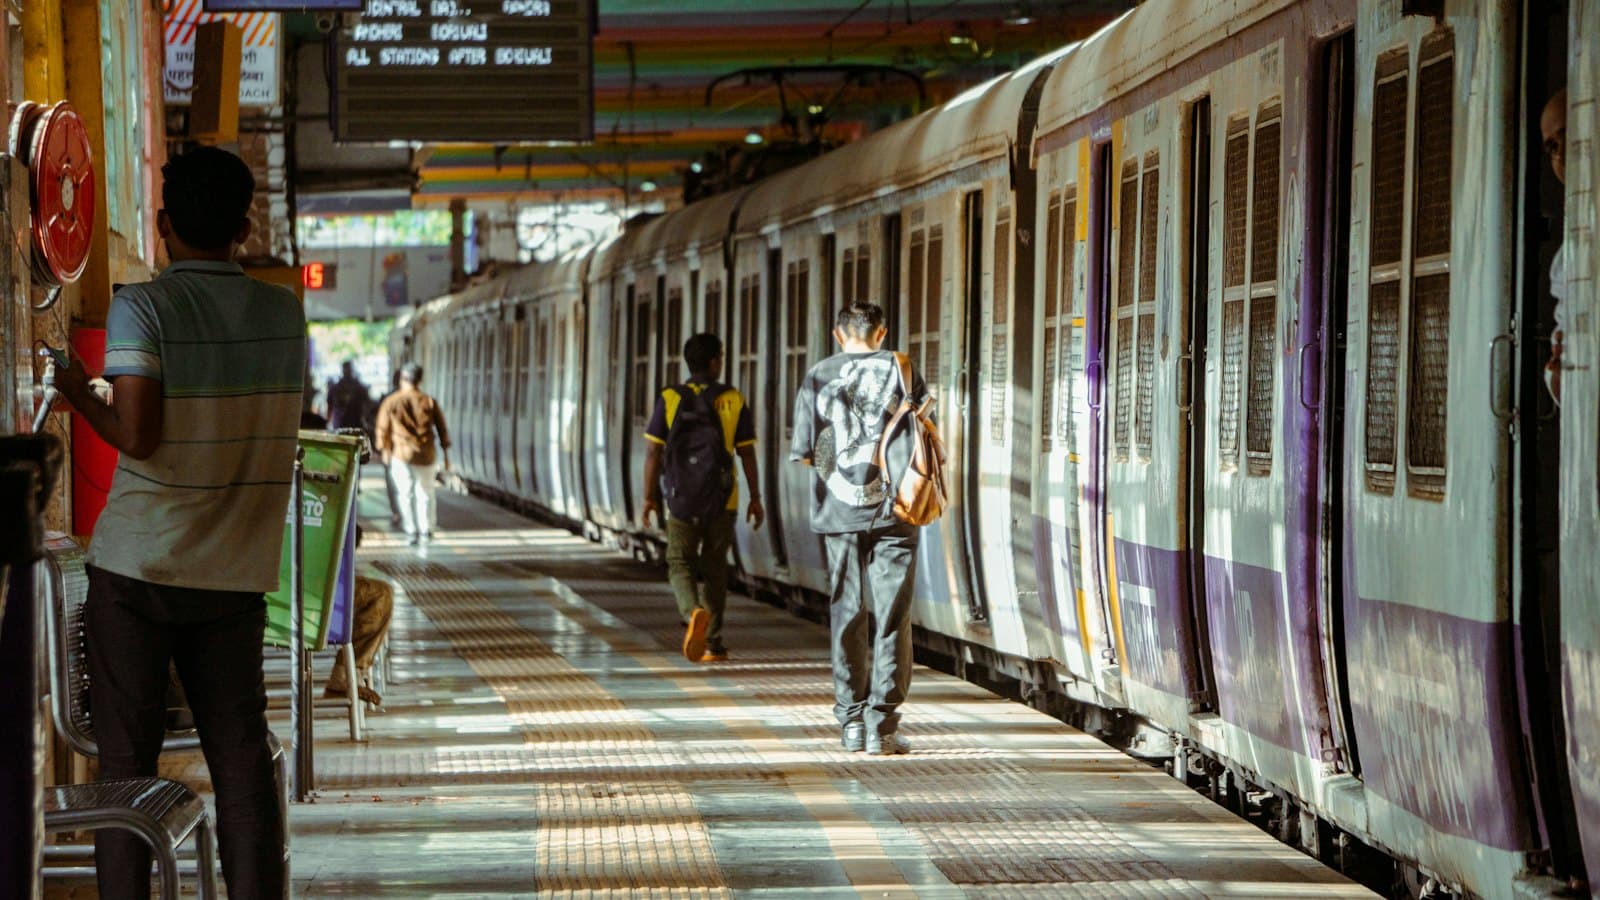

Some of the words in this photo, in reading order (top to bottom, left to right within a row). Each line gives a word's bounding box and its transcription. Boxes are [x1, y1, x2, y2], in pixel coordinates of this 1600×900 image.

[345, 47, 371, 66] ALL
[379, 47, 440, 65] STATIONS
[448, 47, 487, 65] AFTER
